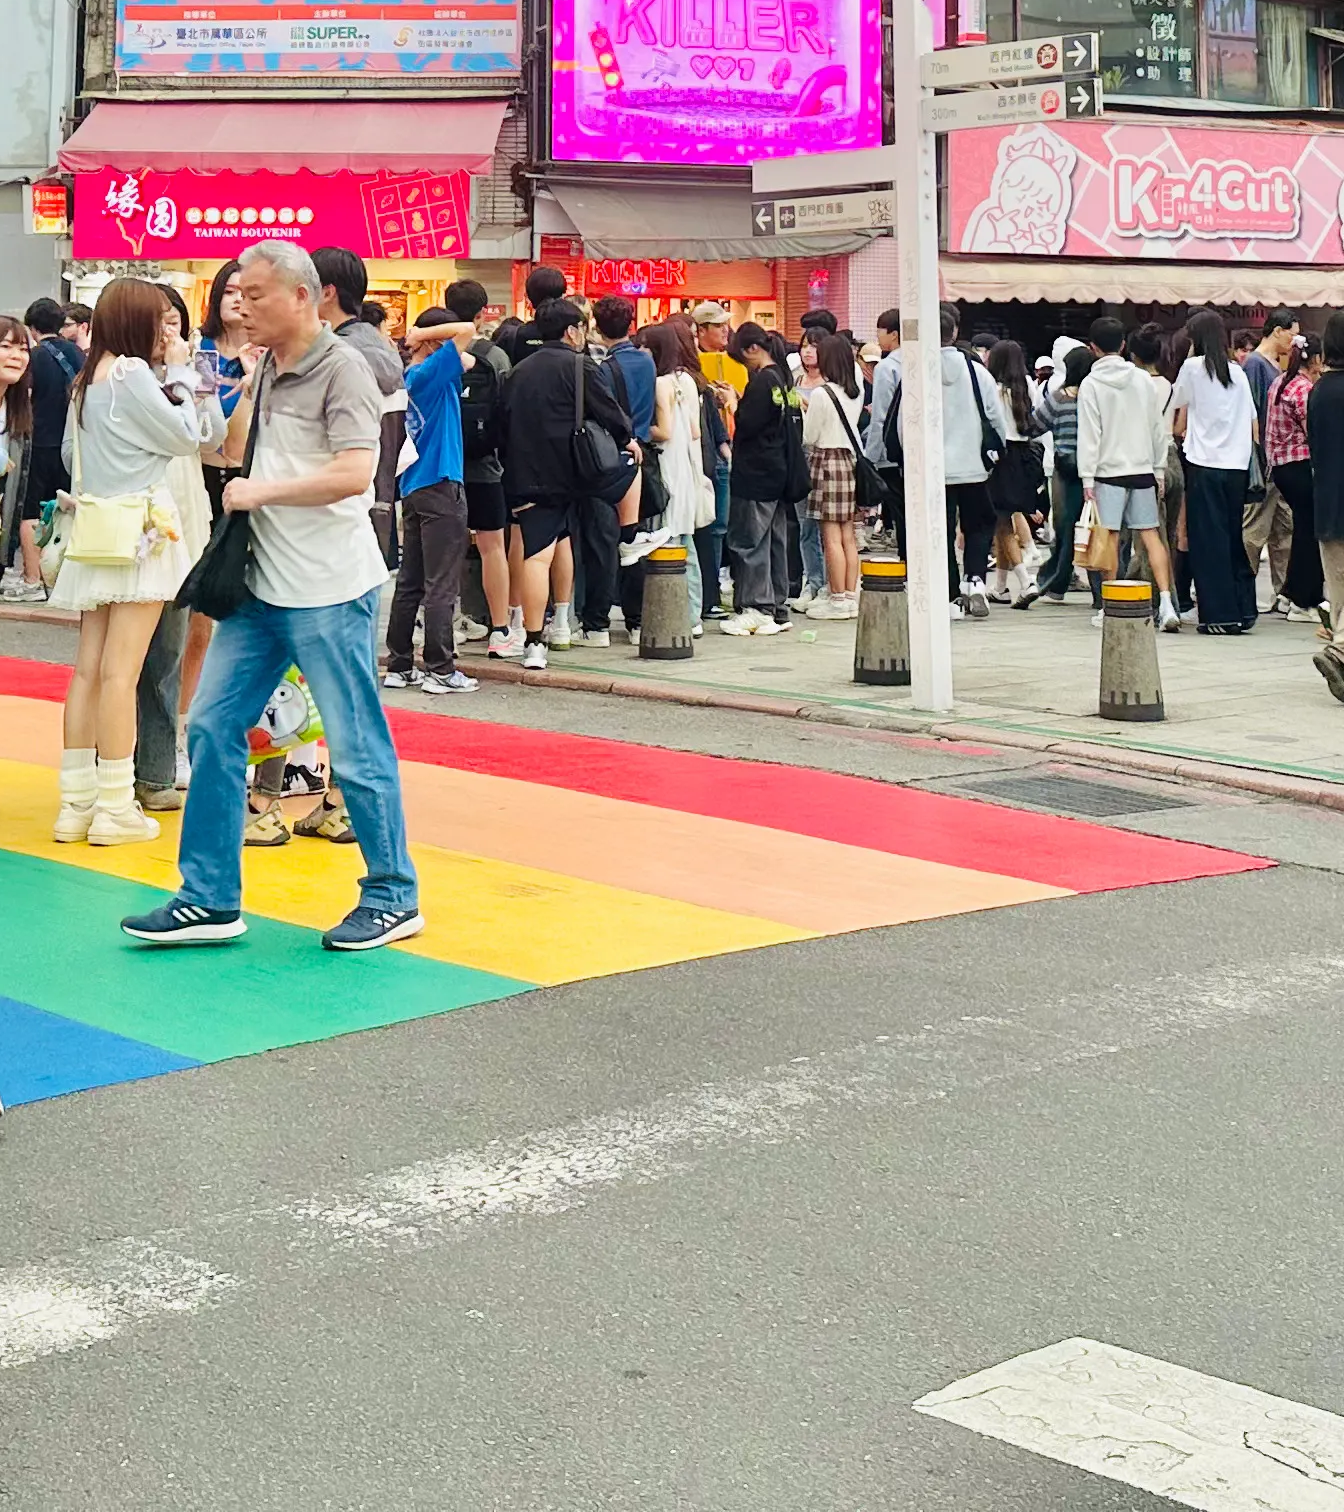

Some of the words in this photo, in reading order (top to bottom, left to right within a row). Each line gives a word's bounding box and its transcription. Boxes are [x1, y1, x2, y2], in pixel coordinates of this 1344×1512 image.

[306, 25, 359, 41] SUPER
[193, 227, 239, 238] TAIWAN
[241, 227, 302, 238] SOUVENIR
[590, 259, 685, 286] KILLER
